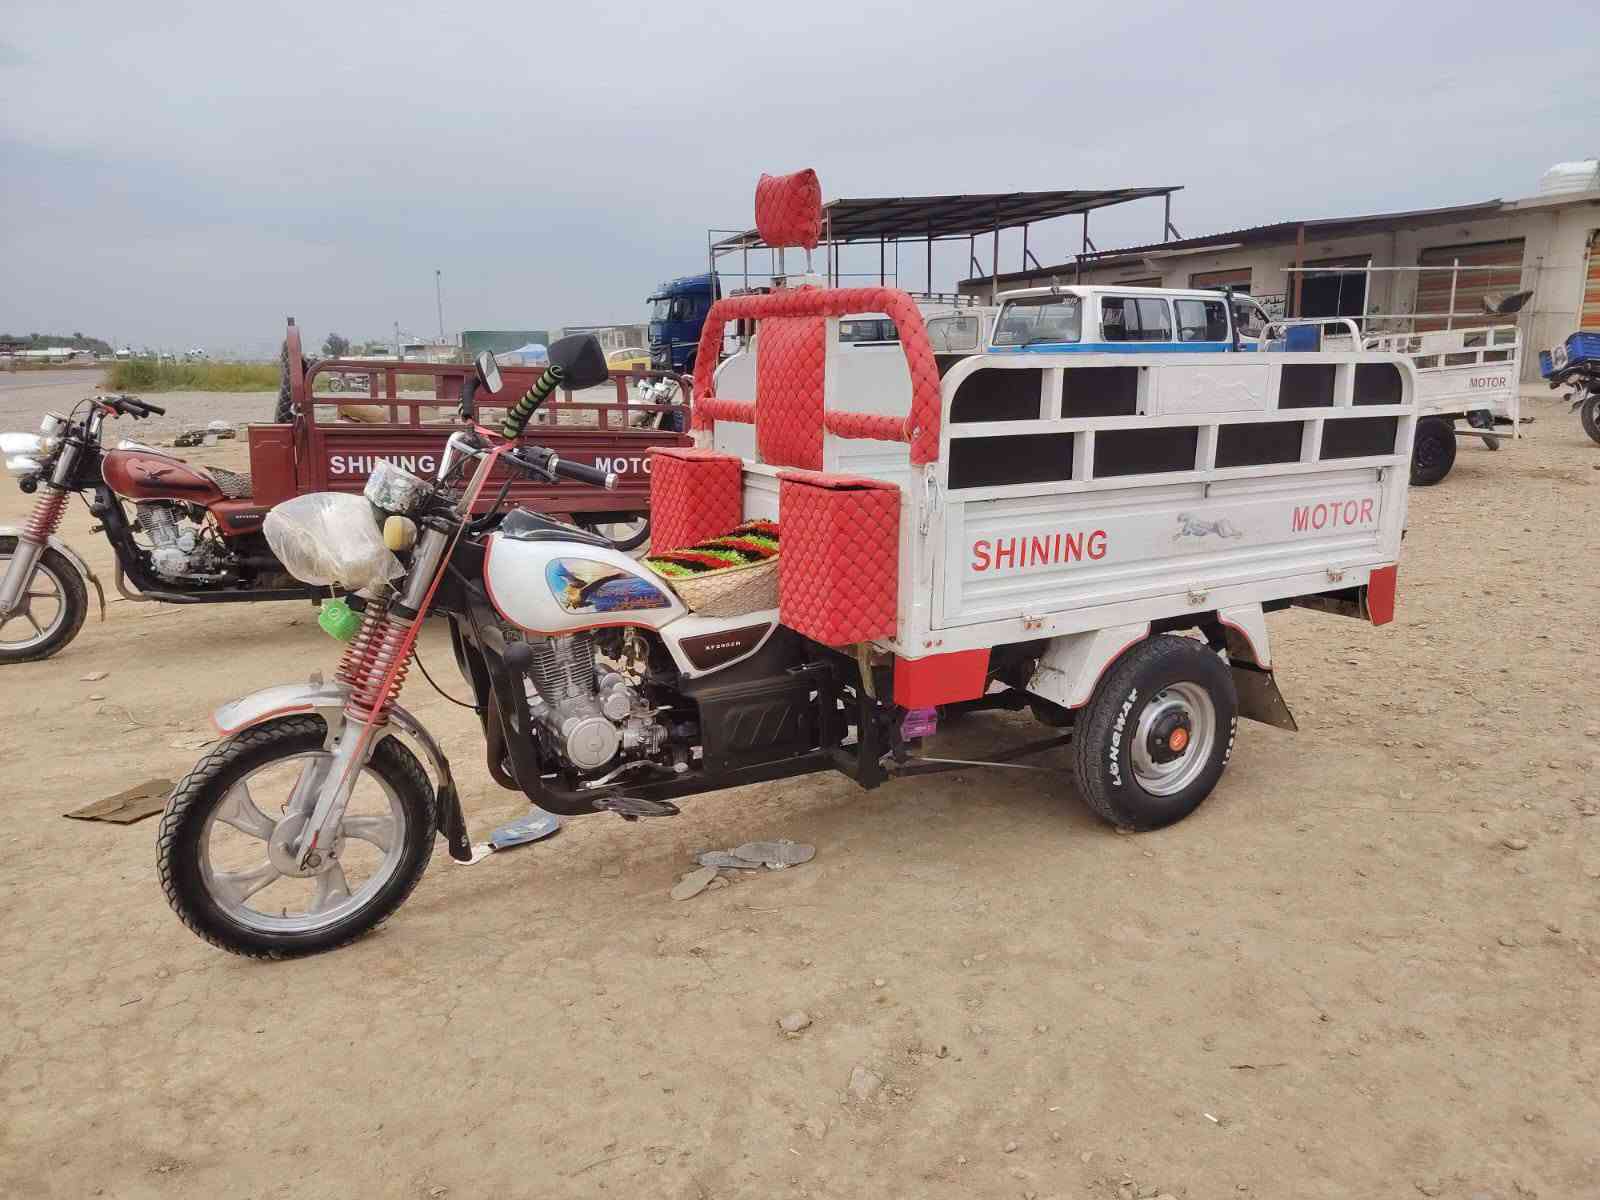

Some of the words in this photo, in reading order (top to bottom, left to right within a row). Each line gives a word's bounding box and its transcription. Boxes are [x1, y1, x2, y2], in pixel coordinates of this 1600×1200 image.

[1471, 377, 1505, 388] MOTOR
[971, 529, 1106, 572] SHINING
[1292, 498, 1374, 532] MOTOR
[1109, 687, 1138, 786] LONGWAY
